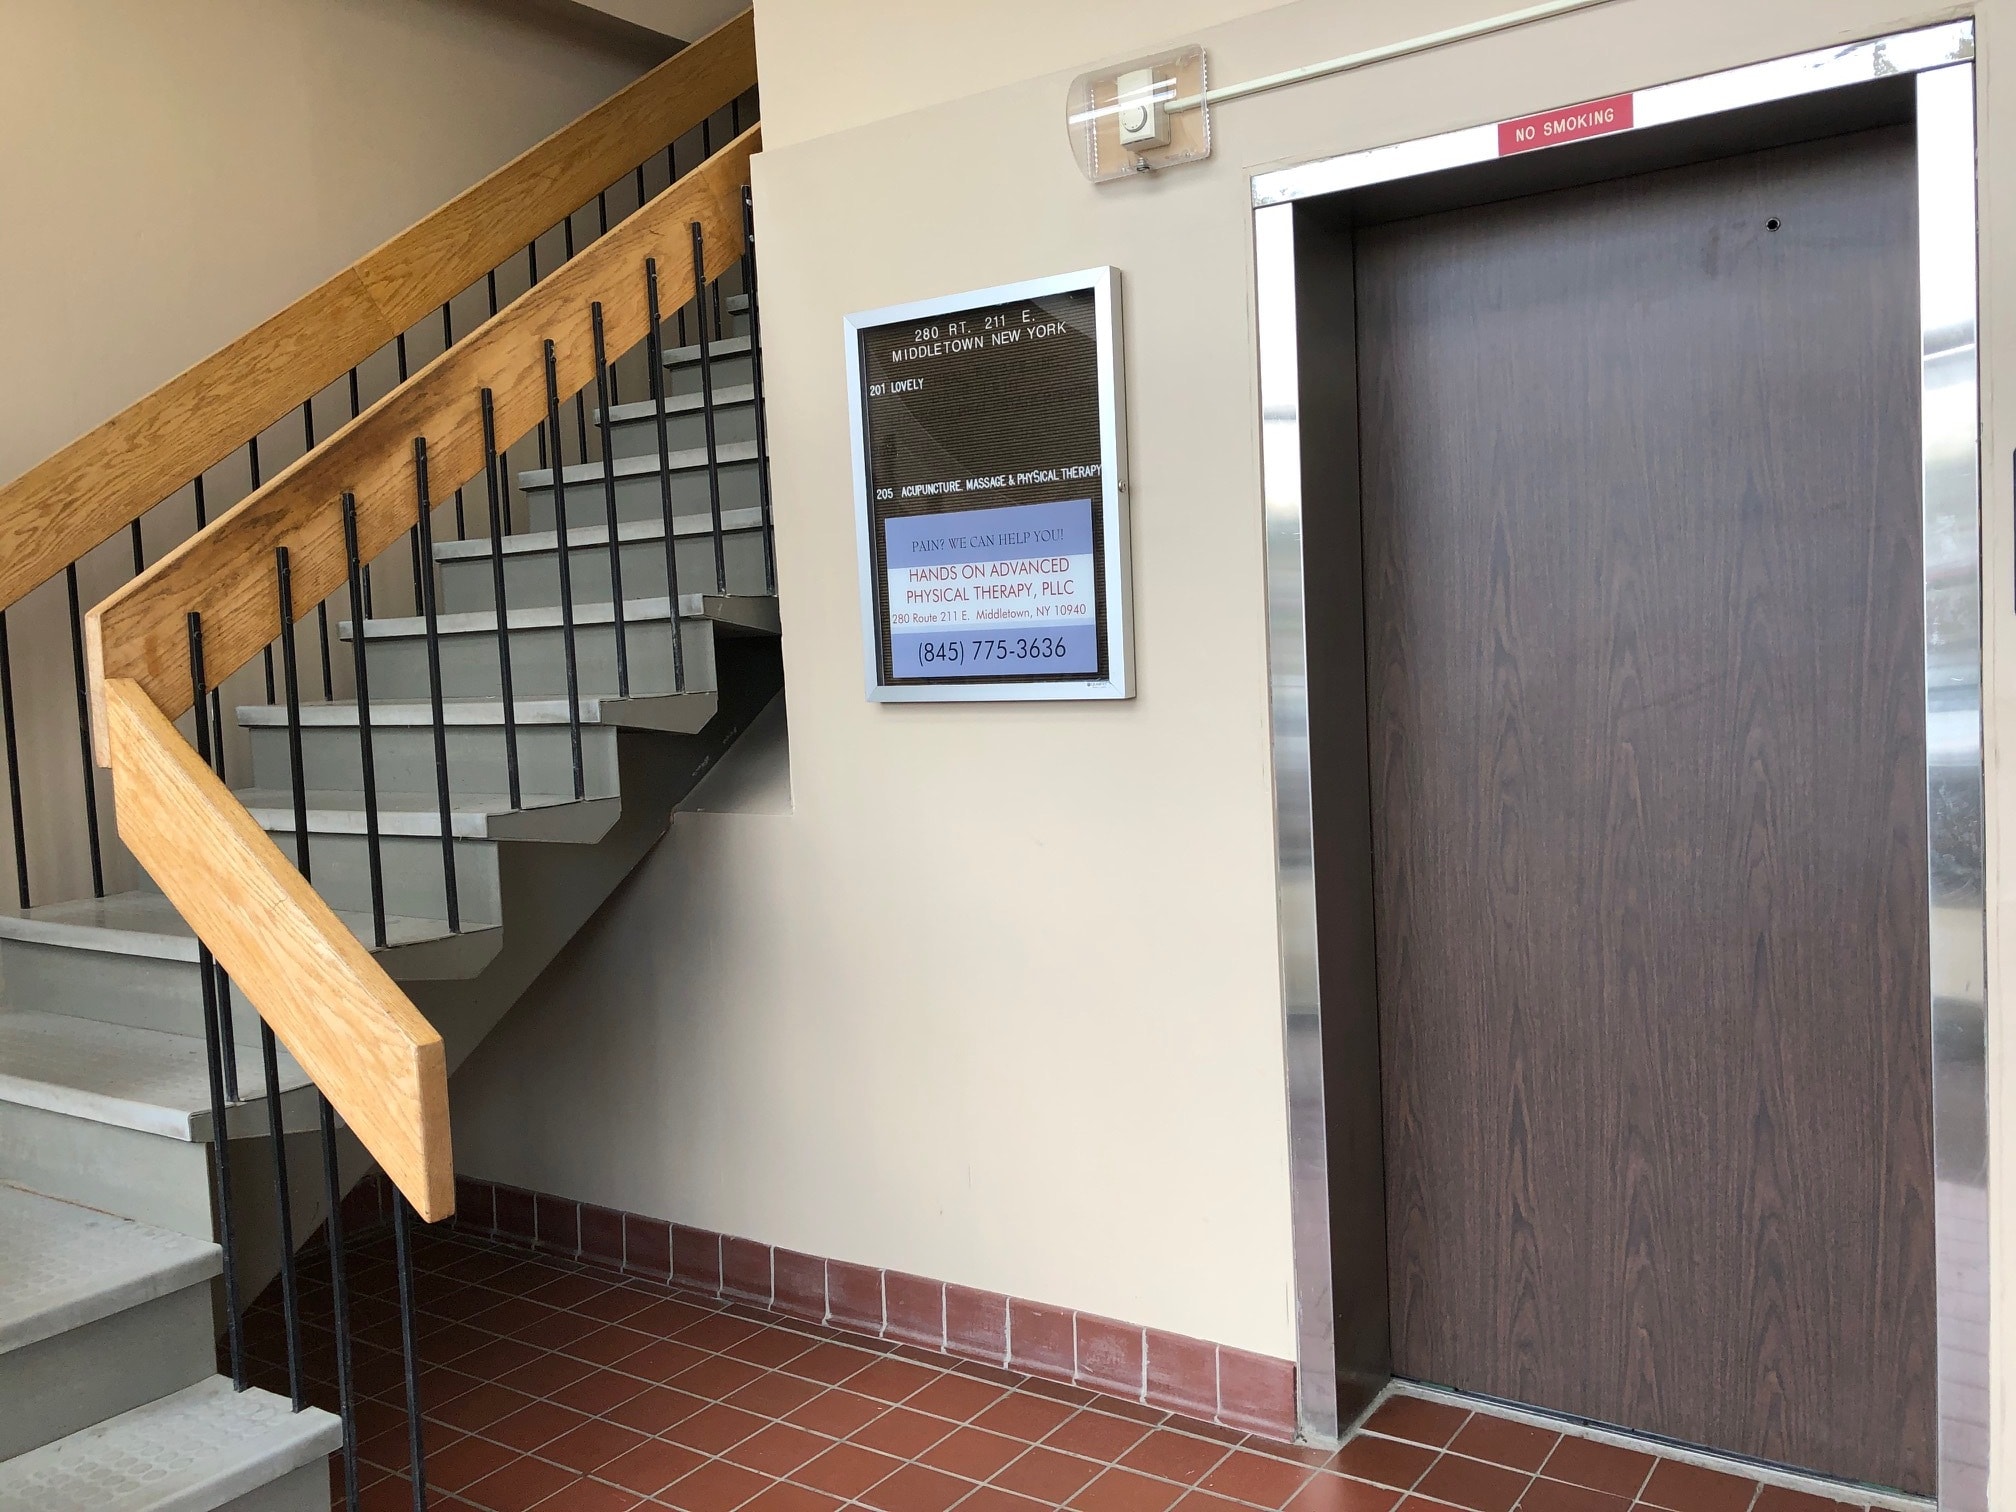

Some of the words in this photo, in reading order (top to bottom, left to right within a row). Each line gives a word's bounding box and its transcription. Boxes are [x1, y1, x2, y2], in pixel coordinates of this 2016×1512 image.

[1516, 126, 1535, 142] NO
[1543, 108, 1614, 136] SMOKING
[914, 326, 939, 342] 280
[949, 321, 971, 335] RT.
[985, 314, 1005, 329] 211
[1022, 309, 1035, 323] E.
[892, 335, 983, 362] MIDDLETOWN
[991, 329, 1020, 345] NEW
[1027, 321, 1066, 339] YORK
[870, 383, 885, 396] 201
[891, 378, 924, 393] LOVELY
[876, 488, 893, 500] 205
[966, 475, 1006, 490] MASSAGE
[1009, 474, 1015, 485] &
[1017, 468, 1059, 484] PHYSICAL
[1061, 464, 1102, 479] THERAPY
[912, 538, 944, 552] PAIN?
[949, 536, 967, 550] WE
[970, 534, 994, 548] CAN
[999, 531, 1031, 546] HELP
[1033, 529, 1064, 542] YOU!
[909, 564, 957, 583] HANDS
[962, 563, 985, 579] ON
[990, 557, 1069, 577] ADVANCED
[907, 587, 969, 604] PHYSICAL
[974, 583, 1036, 601] THERAPY,
[1042, 580, 1074, 596] PLLC
[892, 614, 910, 624] 280
[913, 613, 937, 623] Route
[941, 612, 957, 622] 211
[962, 611, 969, 621] E.
[976, 607, 1033, 620] Middletown,
[1036, 606, 1050, 616] NY
[1054, 604, 1086, 615] 10940
[918, 640, 964, 667] (845)
[972, 637, 1066, 660] 775-3636
